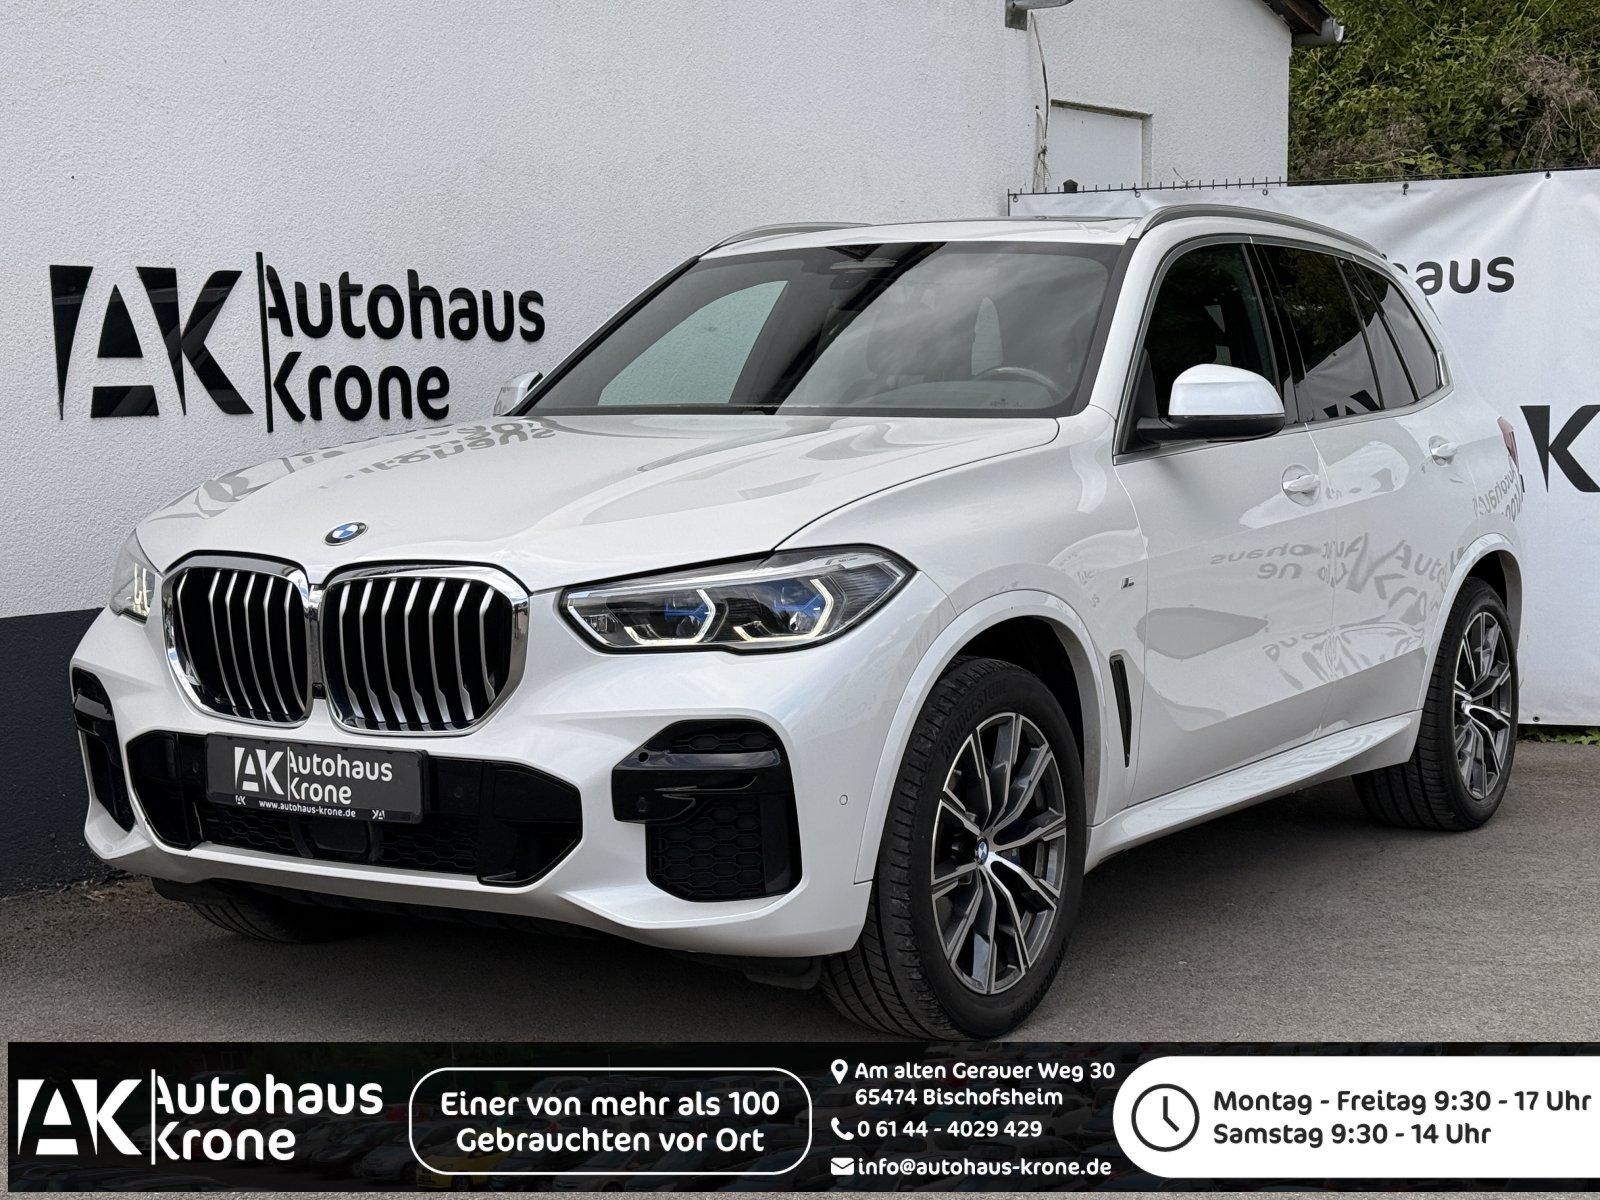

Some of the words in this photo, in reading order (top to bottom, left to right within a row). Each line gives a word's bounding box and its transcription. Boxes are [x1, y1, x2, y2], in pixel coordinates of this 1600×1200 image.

[1393, 256, 1515, 296] aus
[266, 264, 546, 343] Autohaus
[49, 264, 254, 420] AK
[272, 350, 450, 422] Krone
[234, 746, 285, 795] AK
[289, 750, 393, 782] Autohaus
[258, 800, 356, 818] www.autohaus-krone.de
[290, 776, 352, 805] Krone
